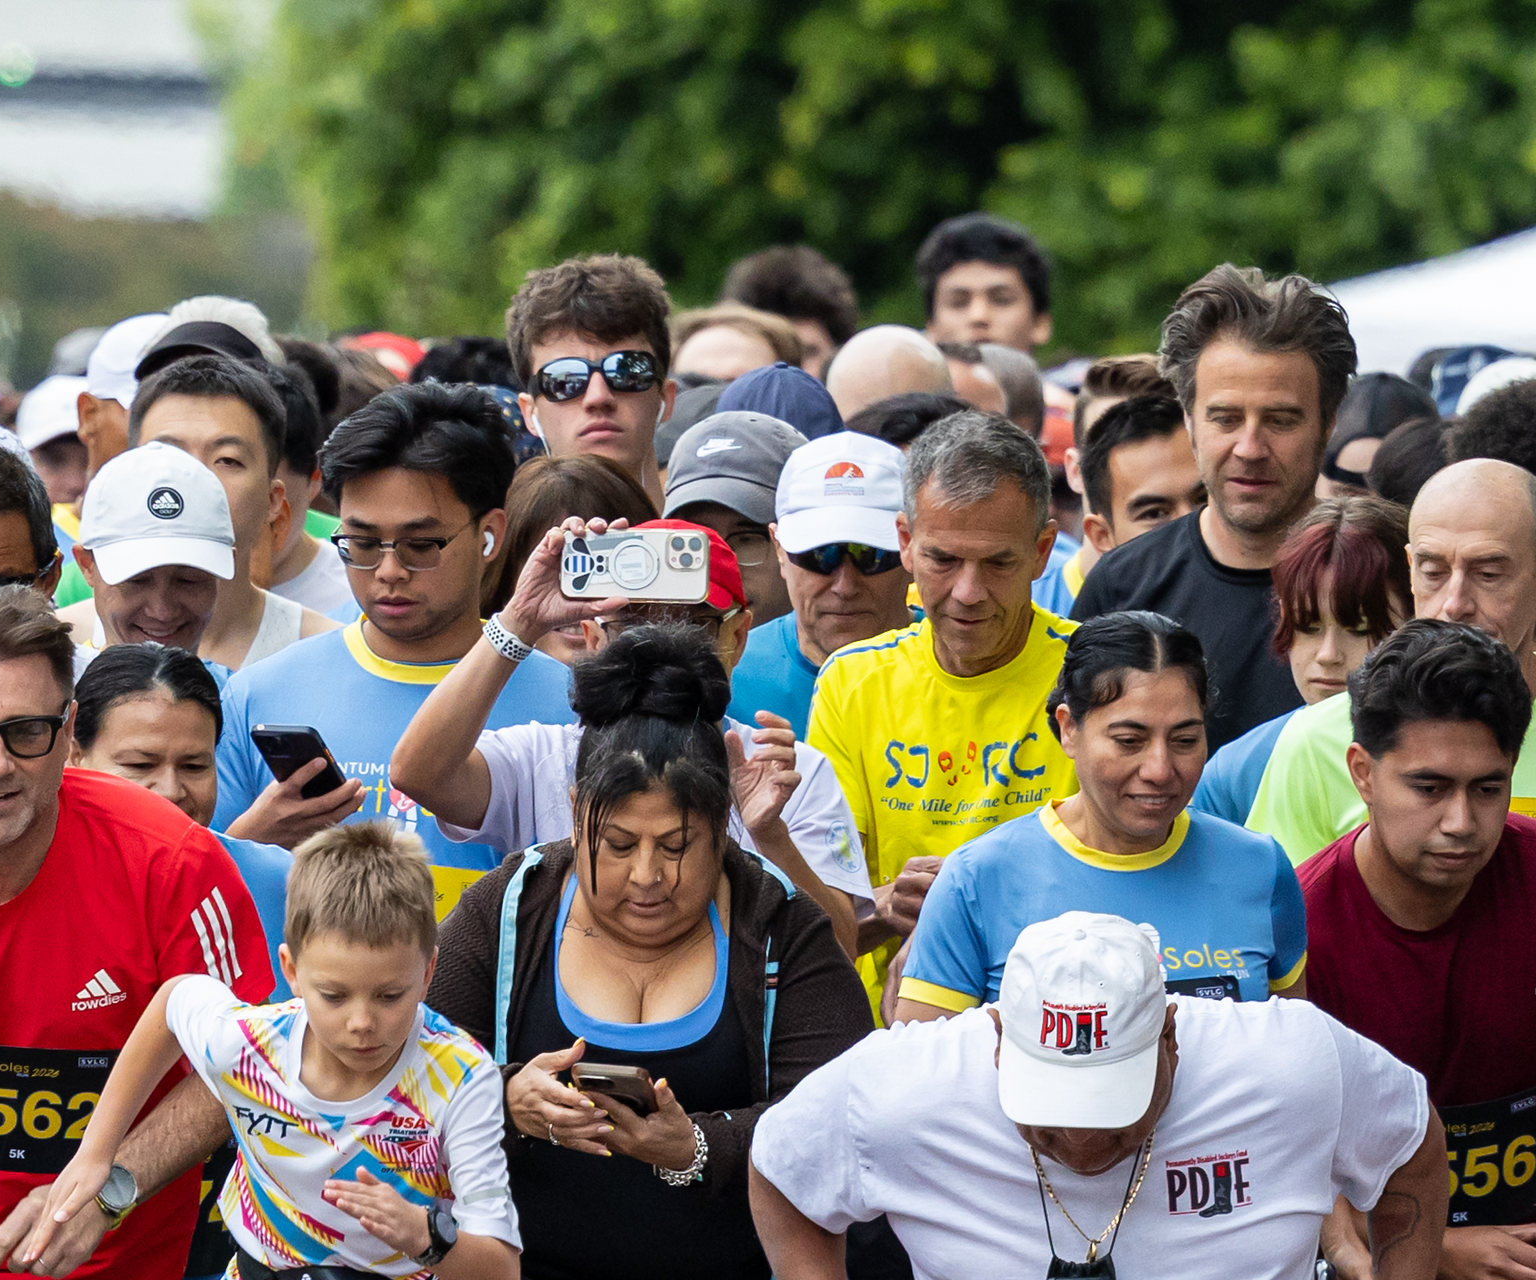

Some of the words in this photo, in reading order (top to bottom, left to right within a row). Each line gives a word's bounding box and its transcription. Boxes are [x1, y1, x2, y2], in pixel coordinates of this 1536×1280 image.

[337, 761, 384, 776] NTUM
[920, 798, 953, 813] Mile
[953, 799, 975, 816] for
[1163, 943, 1245, 970] Soles
[71, 992, 128, 1012] rowdies
[390, 1117, 426, 1130] USA
[8, 1148, 26, 1159] 5K
[1451, 1211, 1469, 1223] 5K
